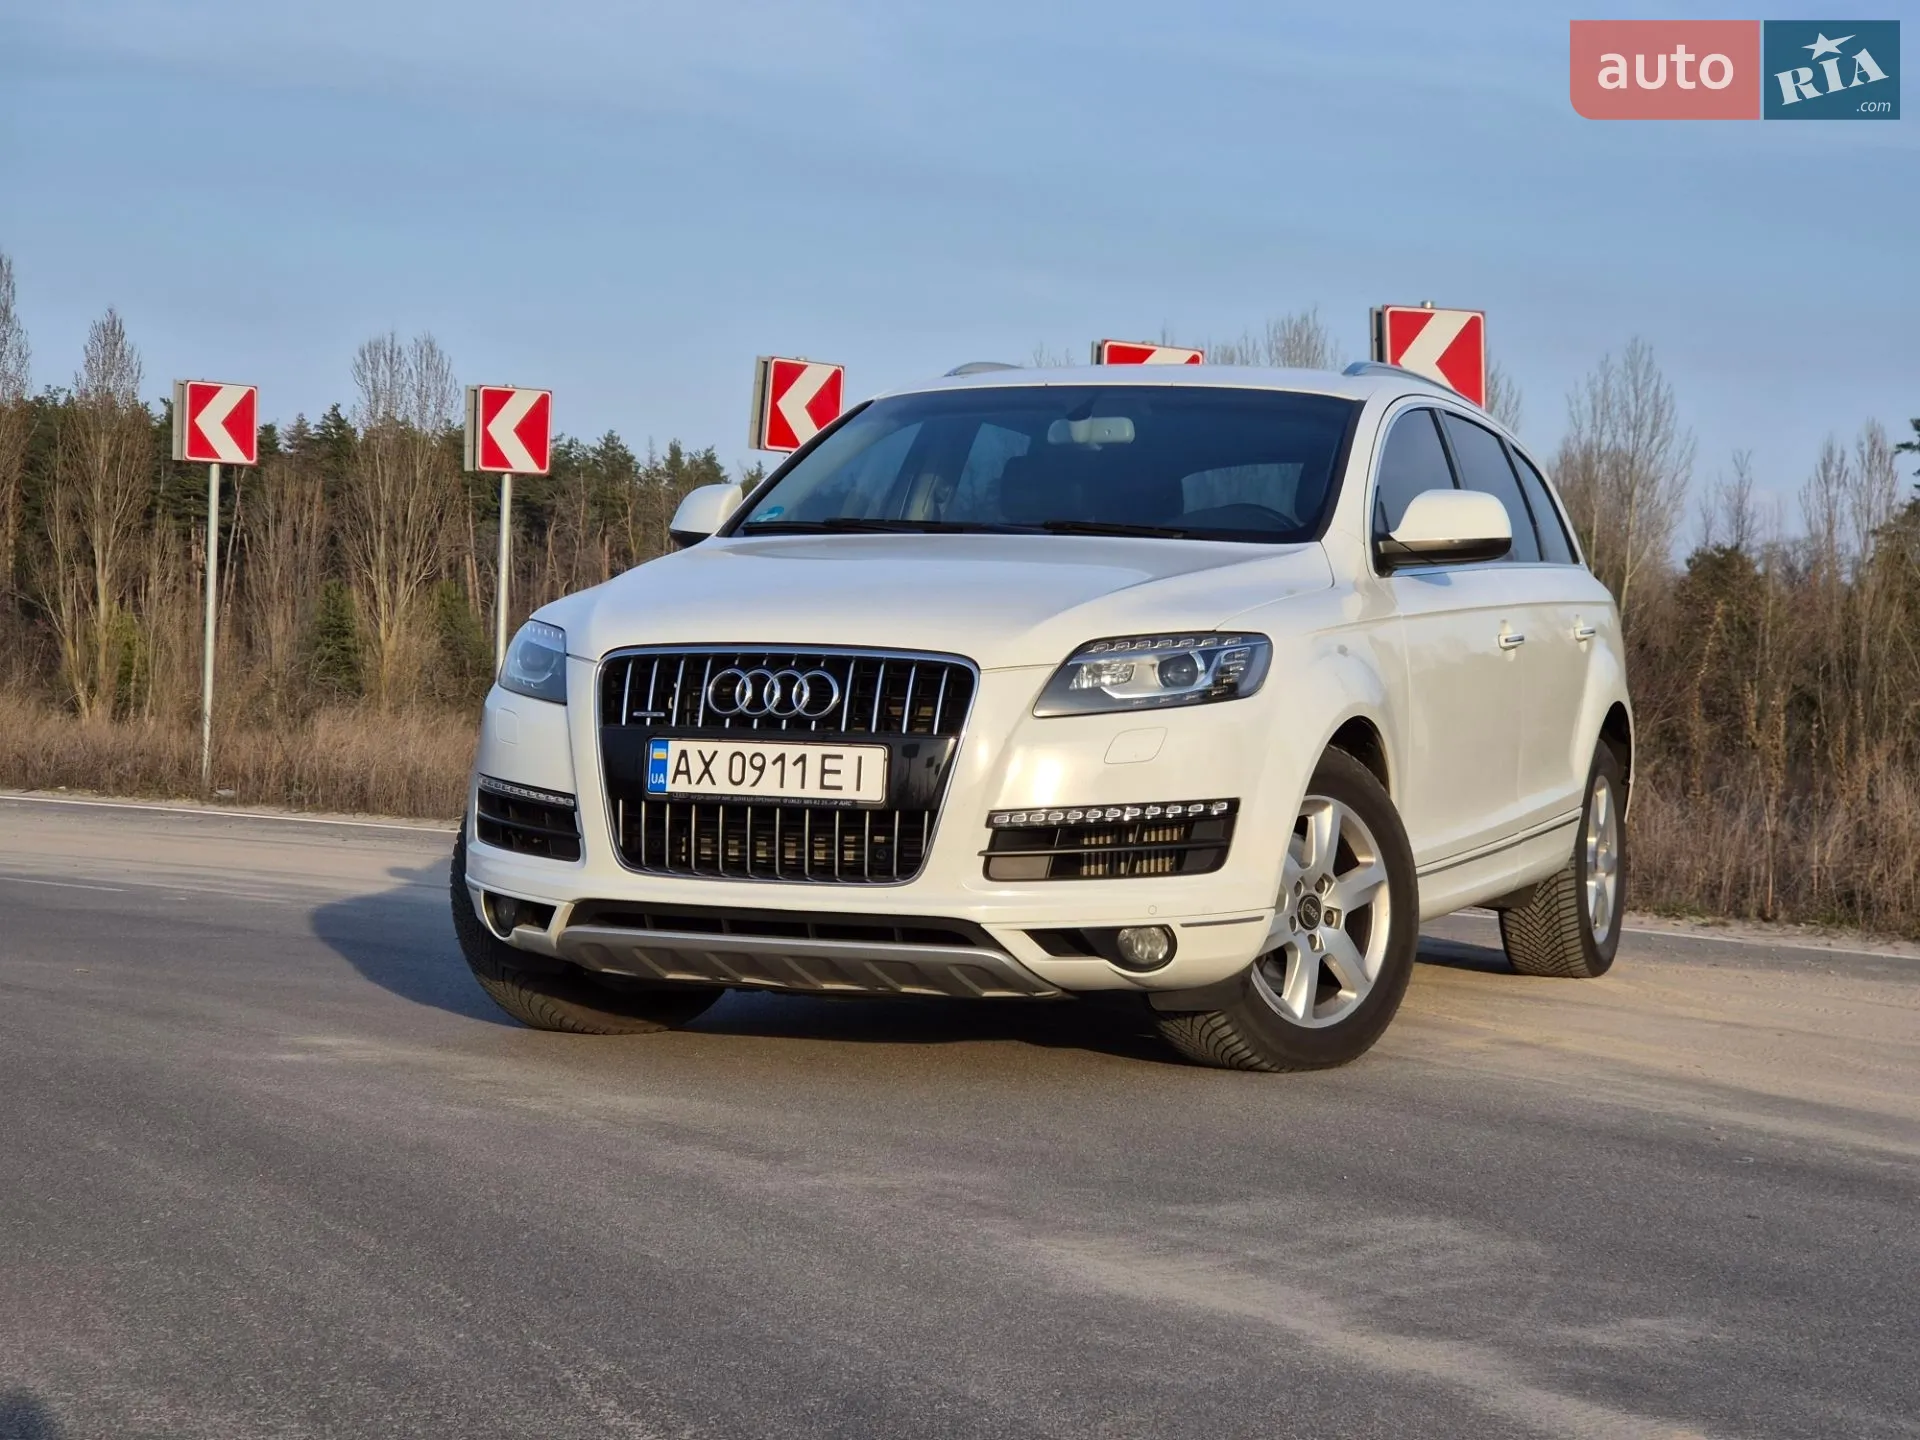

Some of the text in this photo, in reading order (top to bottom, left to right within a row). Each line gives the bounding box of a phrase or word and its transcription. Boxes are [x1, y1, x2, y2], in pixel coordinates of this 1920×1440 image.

[651, 773, 665, 785] UA
[671, 749, 719, 786] AX
[728, 751, 808, 790] 0911
